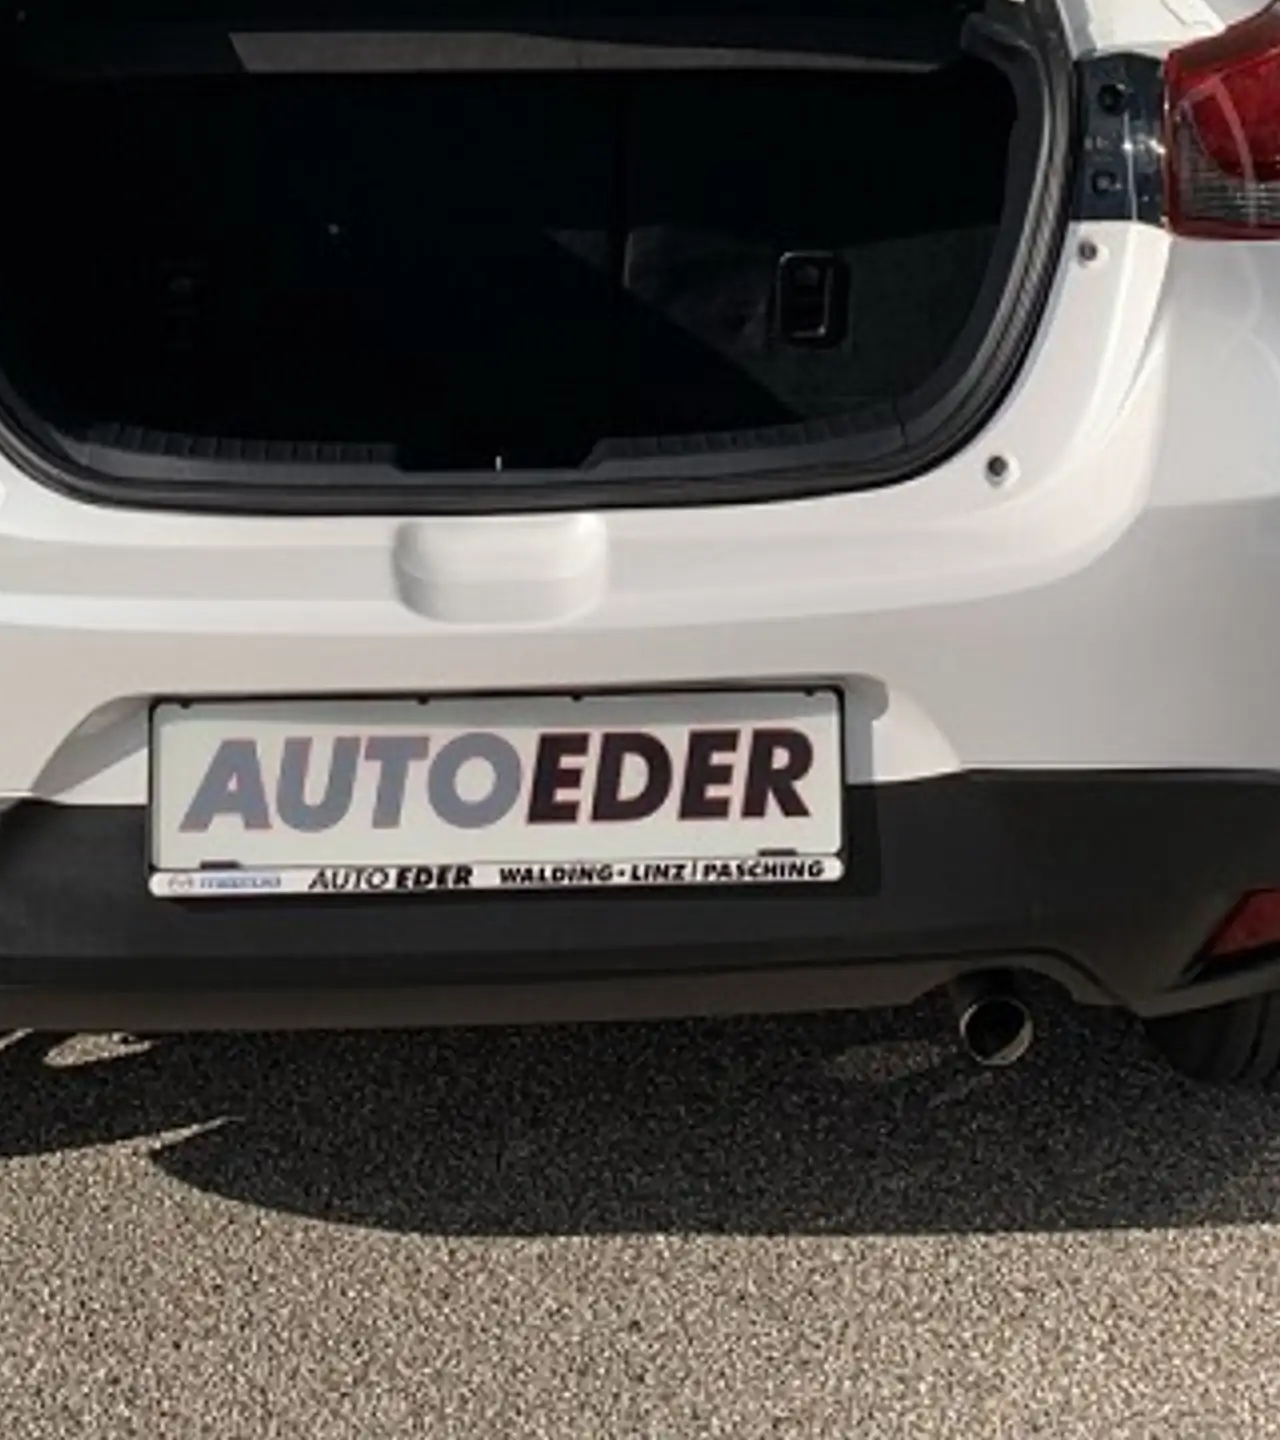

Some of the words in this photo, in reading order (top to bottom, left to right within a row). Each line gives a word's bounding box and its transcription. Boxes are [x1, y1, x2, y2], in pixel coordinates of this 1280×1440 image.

[308, 868, 390, 890] AUTO
[395, 864, 474, 888] EDER
[702, 860, 825, 879] PASCHING
